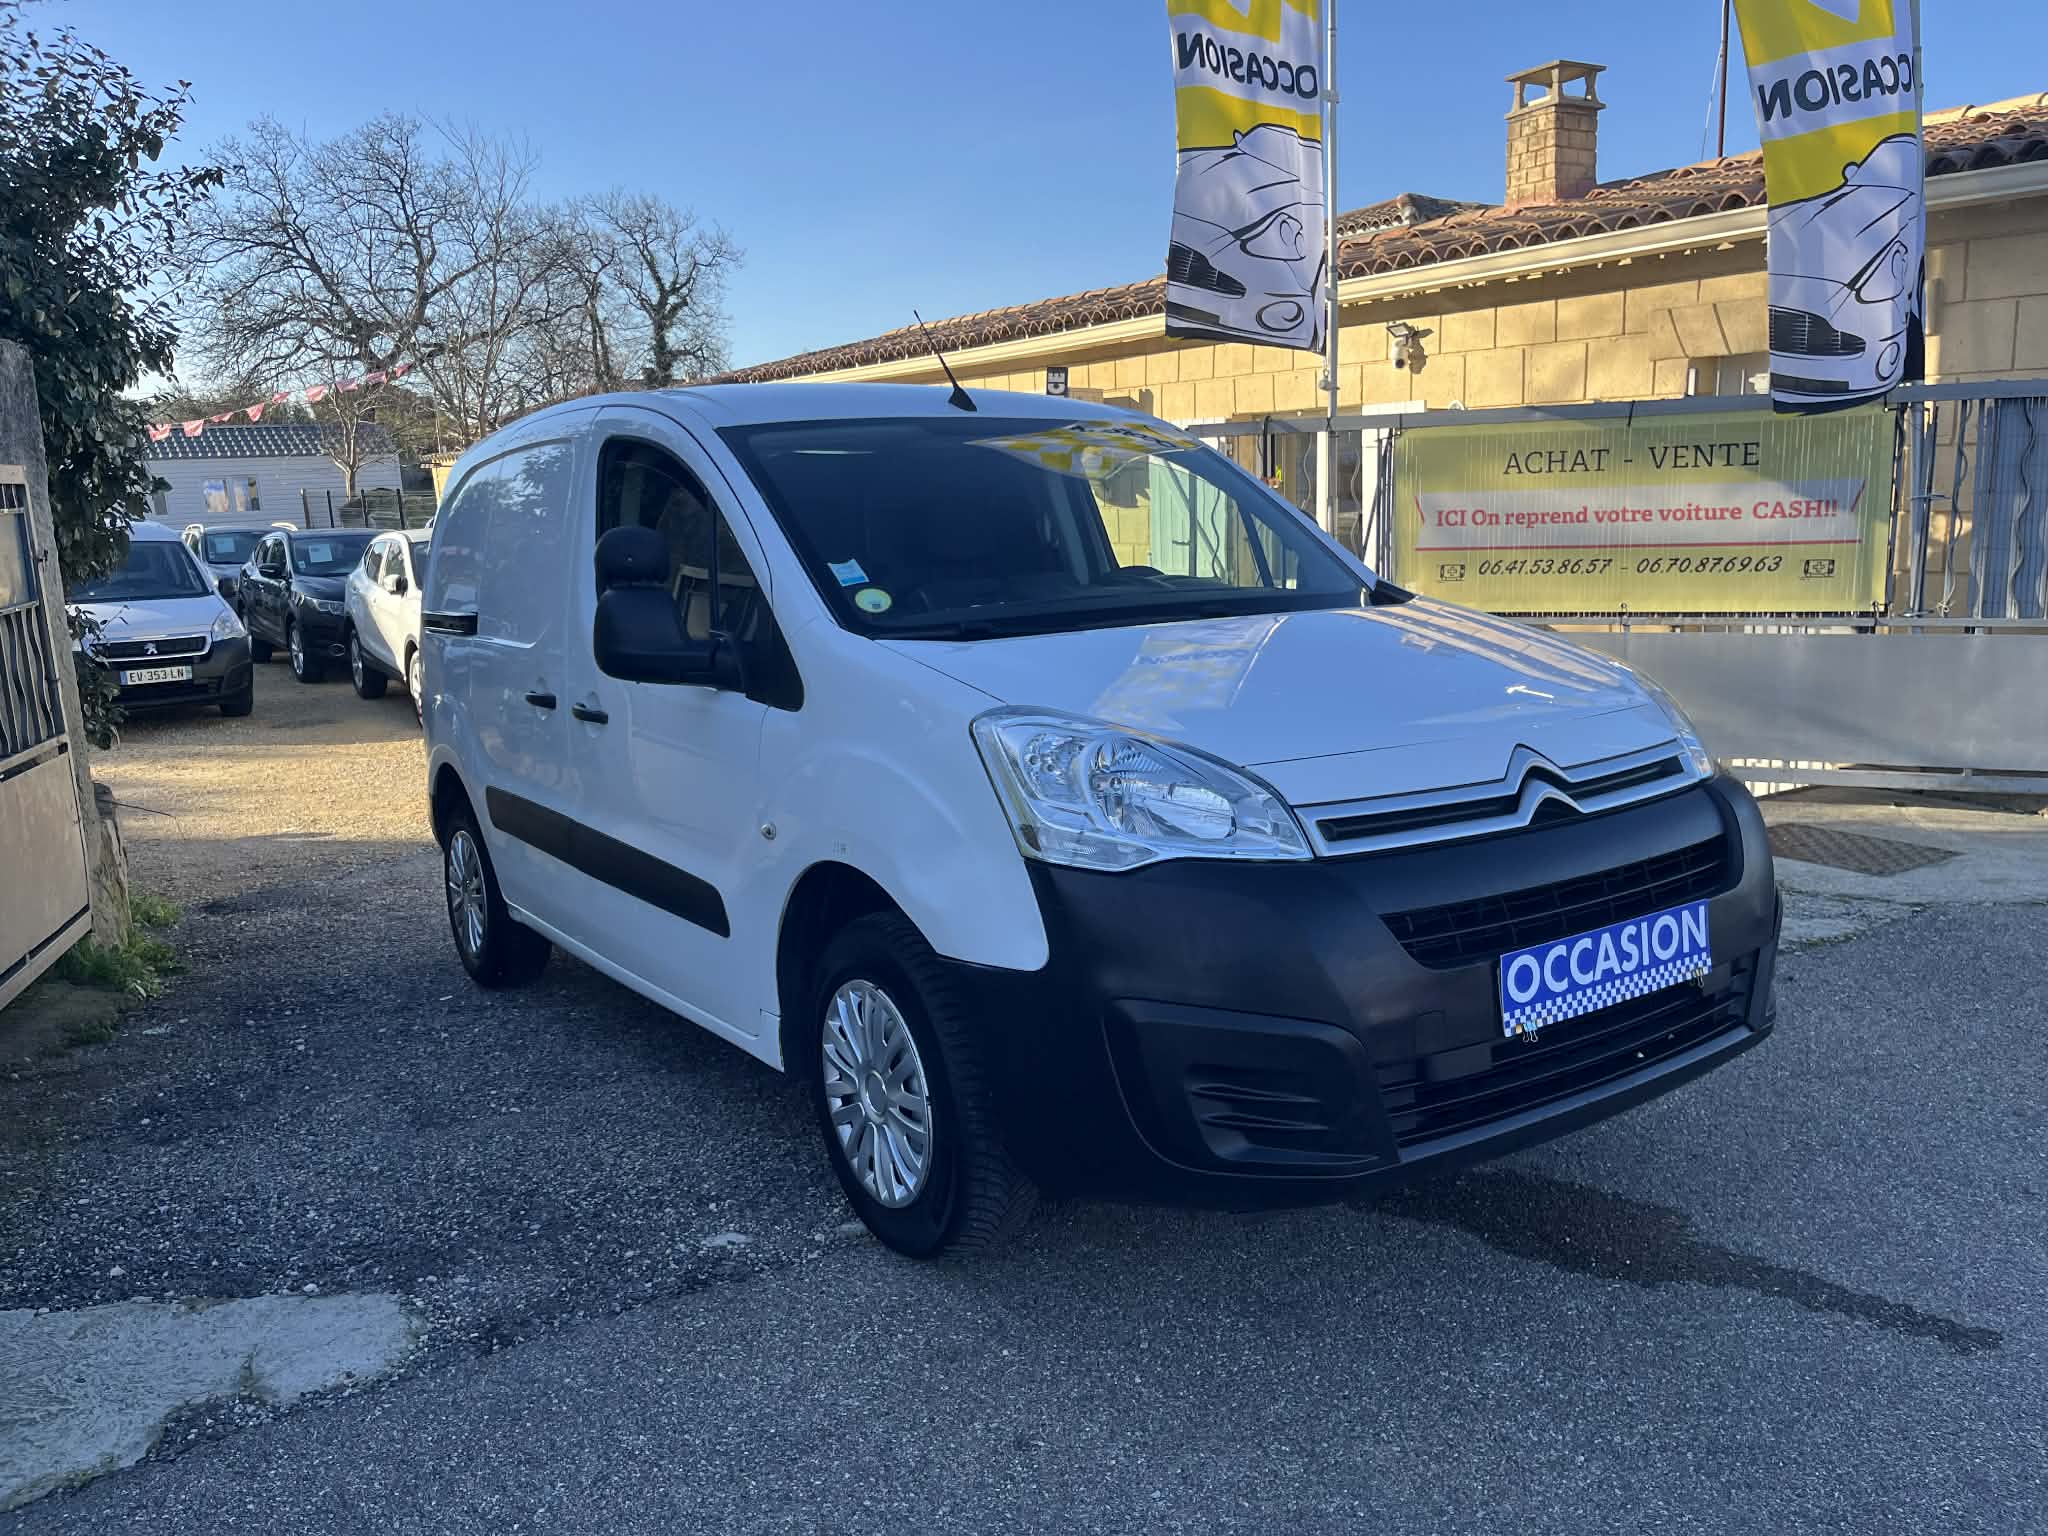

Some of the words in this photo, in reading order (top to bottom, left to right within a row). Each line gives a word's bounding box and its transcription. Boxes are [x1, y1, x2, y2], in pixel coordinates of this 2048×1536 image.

[1503, 448, 1610, 475] ACHAT
[1648, 442, 1760, 470] VENTE
[1436, 509, 1467, 528] ICI
[1471, 508, 1500, 526] On
[1504, 505, 1588, 528] reprend
[1593, 506, 1653, 524] votre
[1658, 502, 1742, 522] voiture
[1752, 499, 1838, 519] CASH!!
[1507, 905, 1706, 1004] OCCASION
